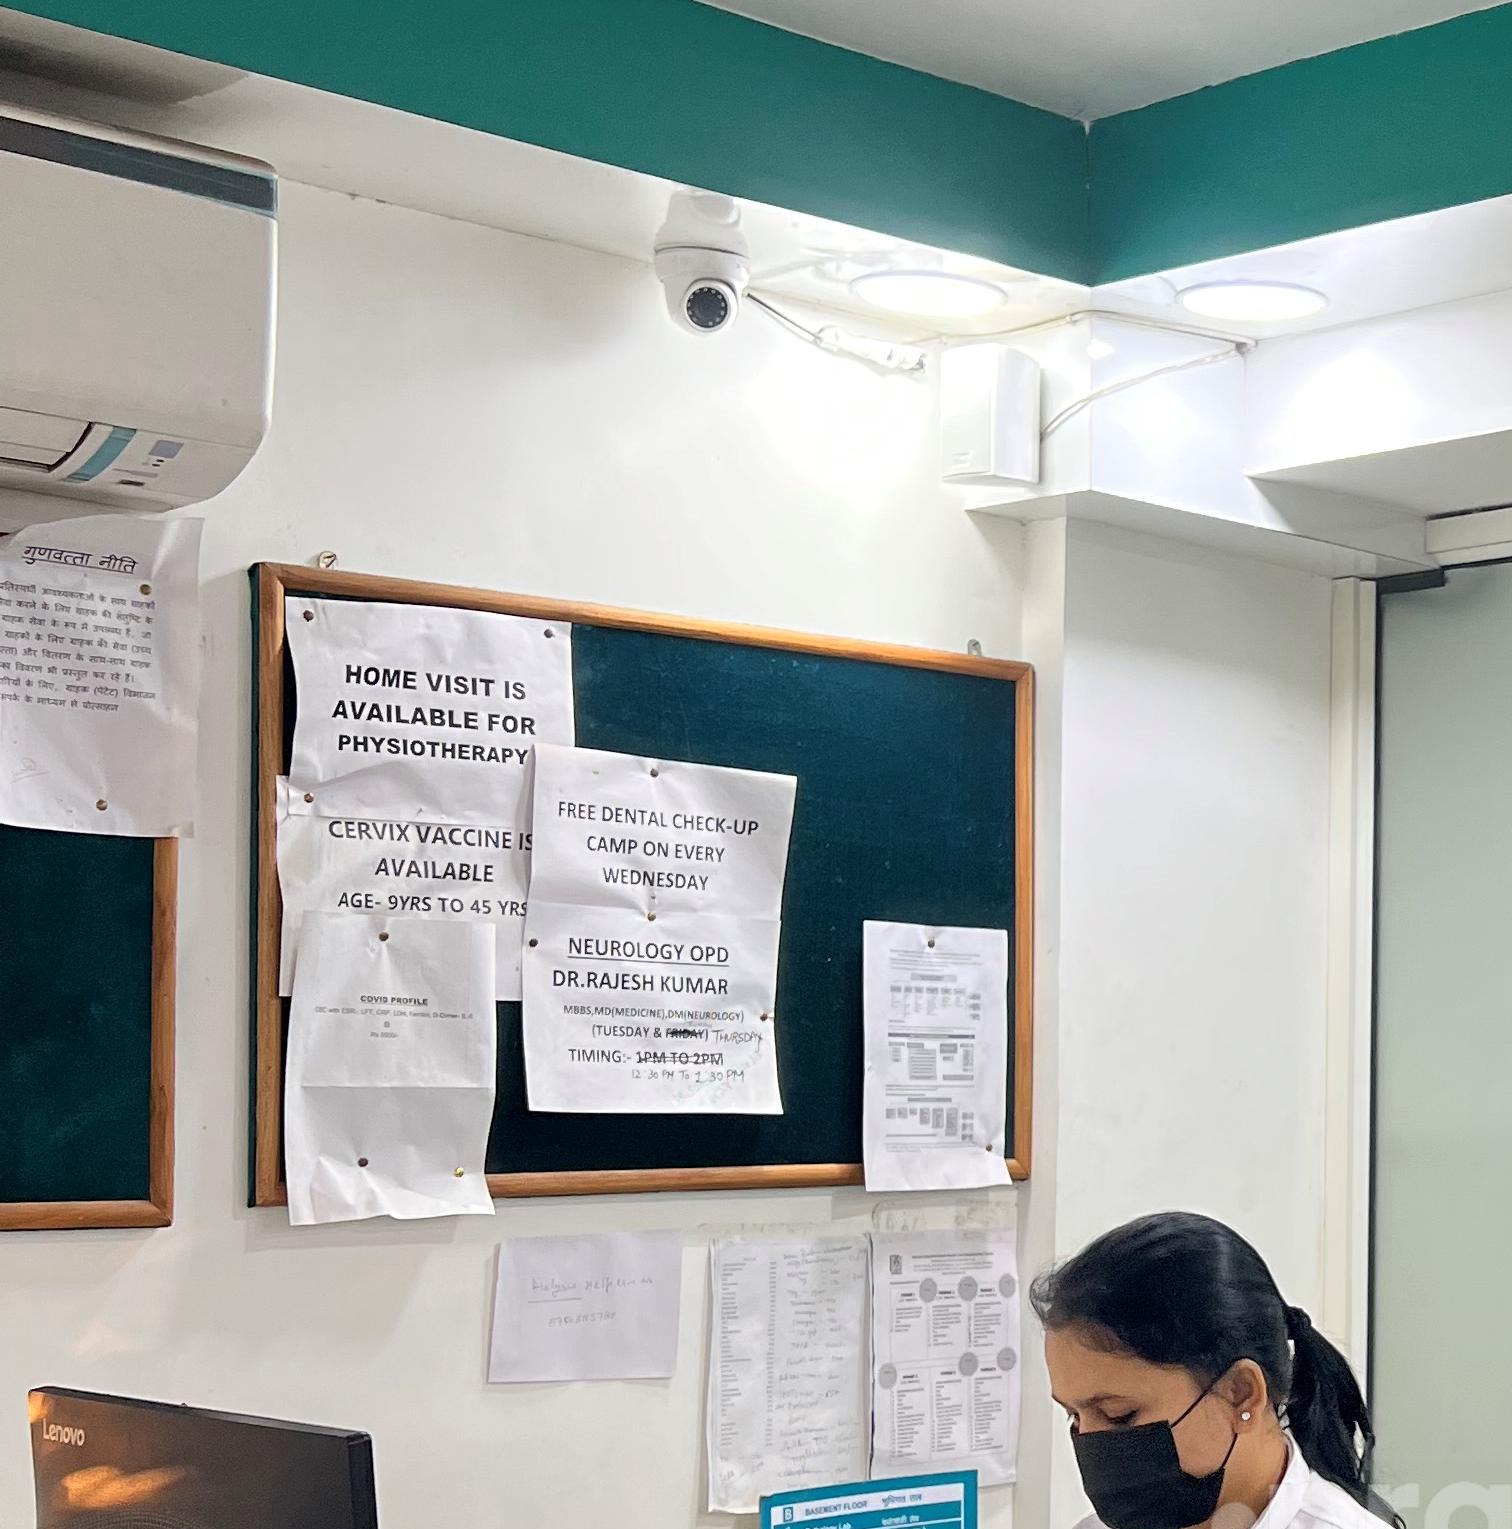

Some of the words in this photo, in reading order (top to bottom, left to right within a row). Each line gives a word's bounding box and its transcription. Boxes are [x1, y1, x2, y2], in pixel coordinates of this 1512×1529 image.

[99, 554, 138, 573] नीति
[345, 664, 417, 690] HOME
[425, 672, 495, 697] VISIT
[504, 680, 526, 700] IS
[332, 700, 478, 730] AVAILABLE
[487, 713, 536, 736] FOR
[338, 734, 528, 765] PHYSIOTHERAPY
[558, 801, 596, 820] FREE
[602, 806, 668, 828] DENTAL
[672, 813, 759, 836] CHECK-UP
[328, 820, 410, 842] CERVIX
[416, 825, 512, 849] VACCINE
[587, 835, 638, 854] CAMP
[643, 841, 669, 858] ON
[675, 843, 725, 863] EVERY
[375, 858, 494, 883] AVAILABLE
[602, 867, 709, 891] WEDNESDAY
[337, 892, 381, 909] AGE-
[388, 894, 432, 912] 9YRS
[438, 897, 464, 913] TO
[470, 899, 491, 914] 45
[497, 900, 527, 917] YRS
[568, 937, 684, 961] NEUROLOGY
[690, 945, 729, 963] OPD
[553, 970, 654, 992] DR.RAJESH
[660, 976, 728, 995] KUMAR
[360, 995, 389, 1005] COVID
[390, 996, 429, 1007] PROFILE
[592, 1024, 650, 1039] (TUESDAY
[653, 1027, 662, 1039] &
[42, 1417, 85, 1447] Lenovo
[805, 1503, 842, 1516] BASEMENT
[843, 1499, 868, 1511] FLOOR
